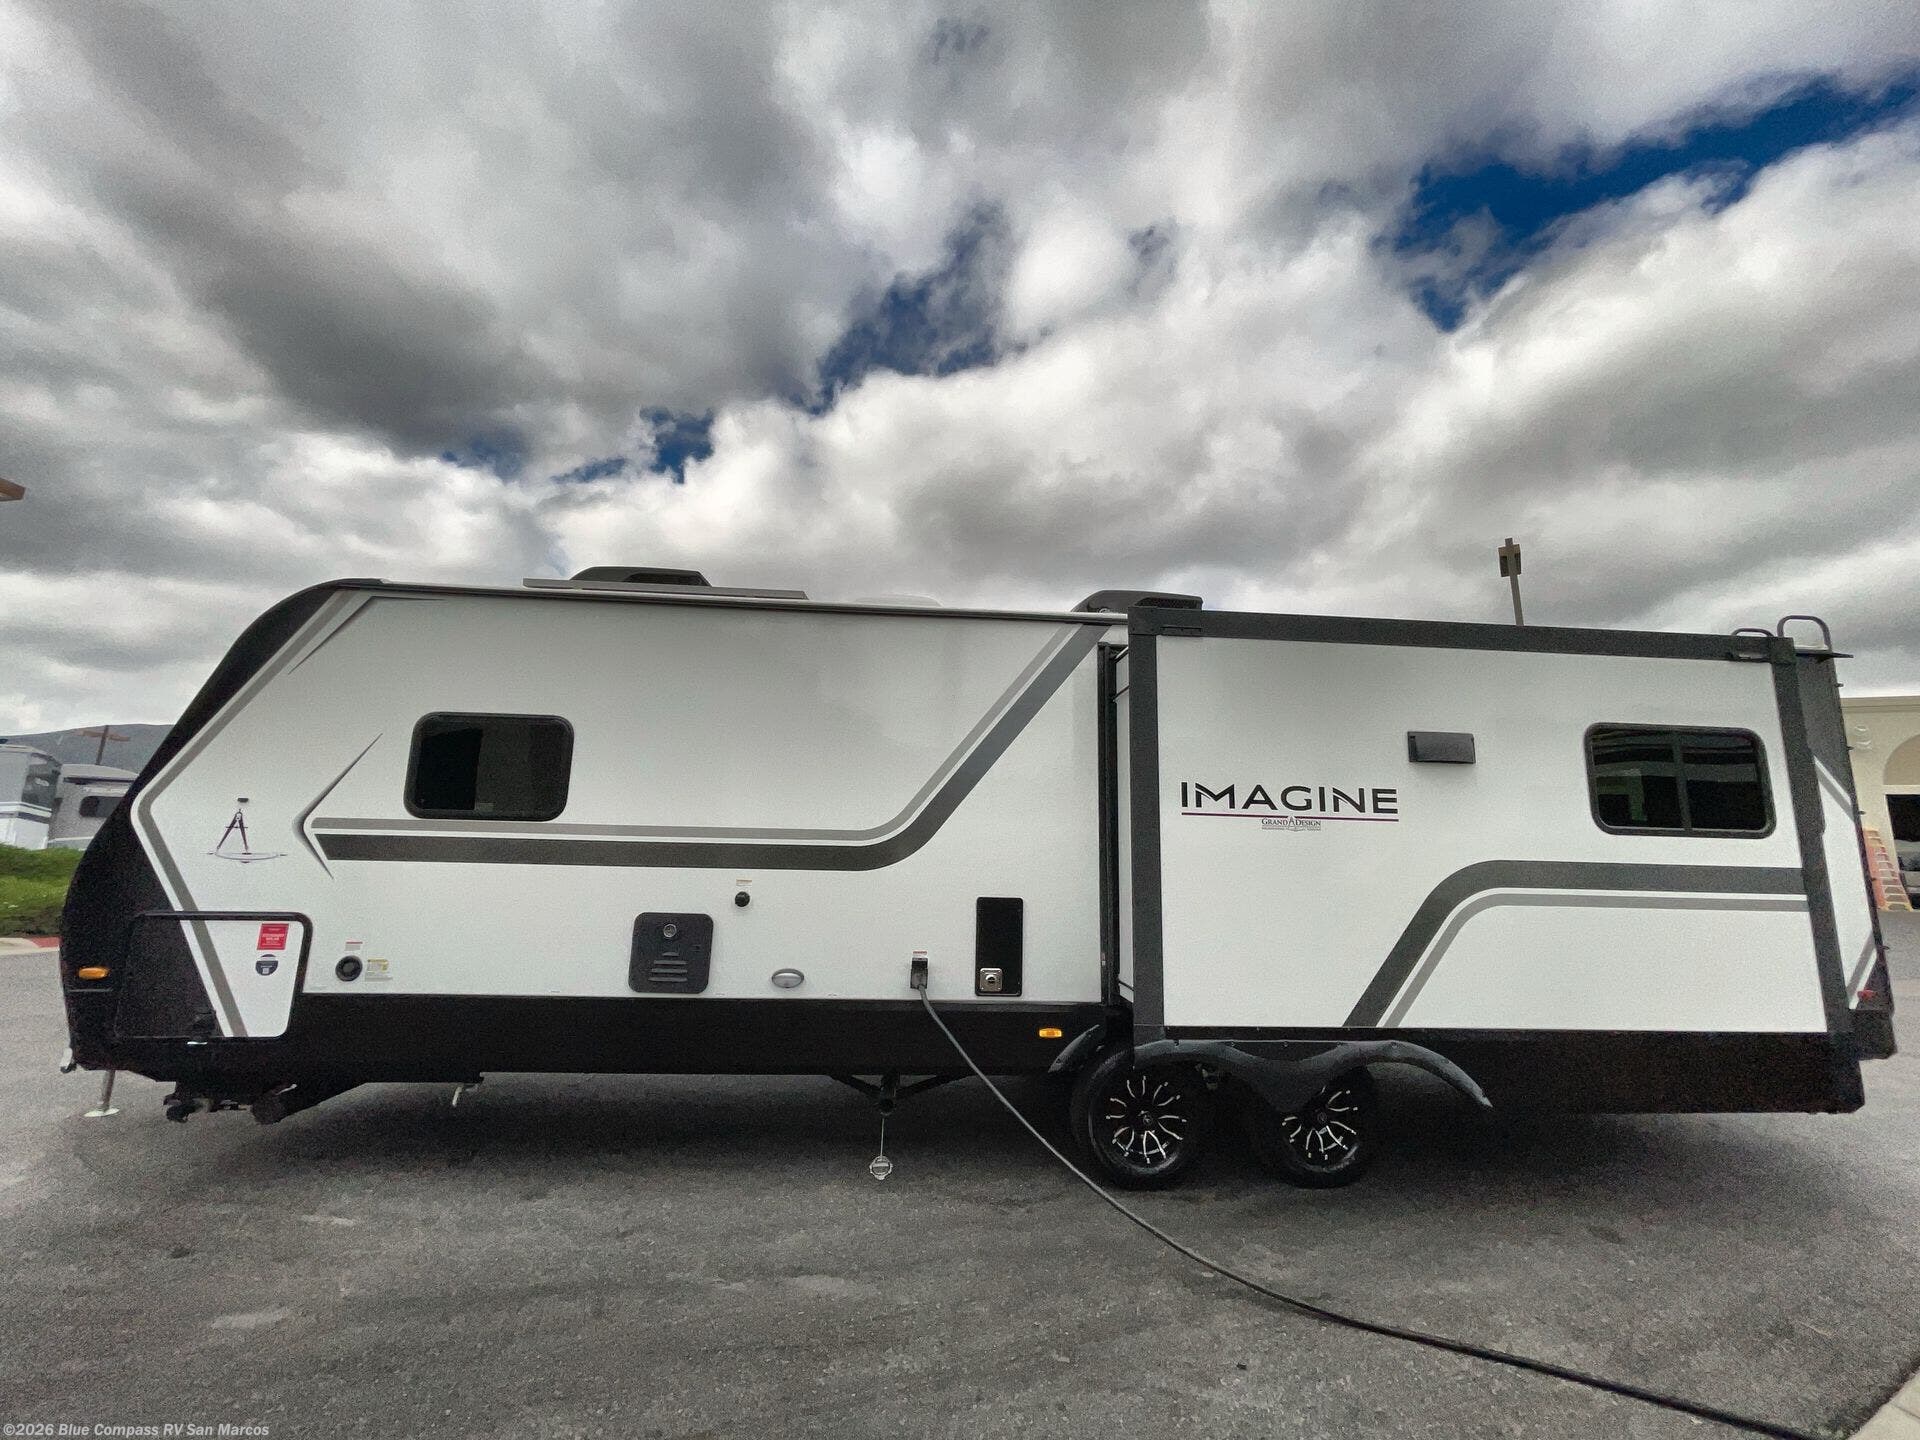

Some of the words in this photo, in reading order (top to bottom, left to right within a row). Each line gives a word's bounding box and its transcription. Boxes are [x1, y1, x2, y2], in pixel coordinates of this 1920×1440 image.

[1181, 781, 1398, 814] IMAGINE
[1261, 817, 1288, 826] GRAND
[1295, 819, 1321, 827] DESIGN
